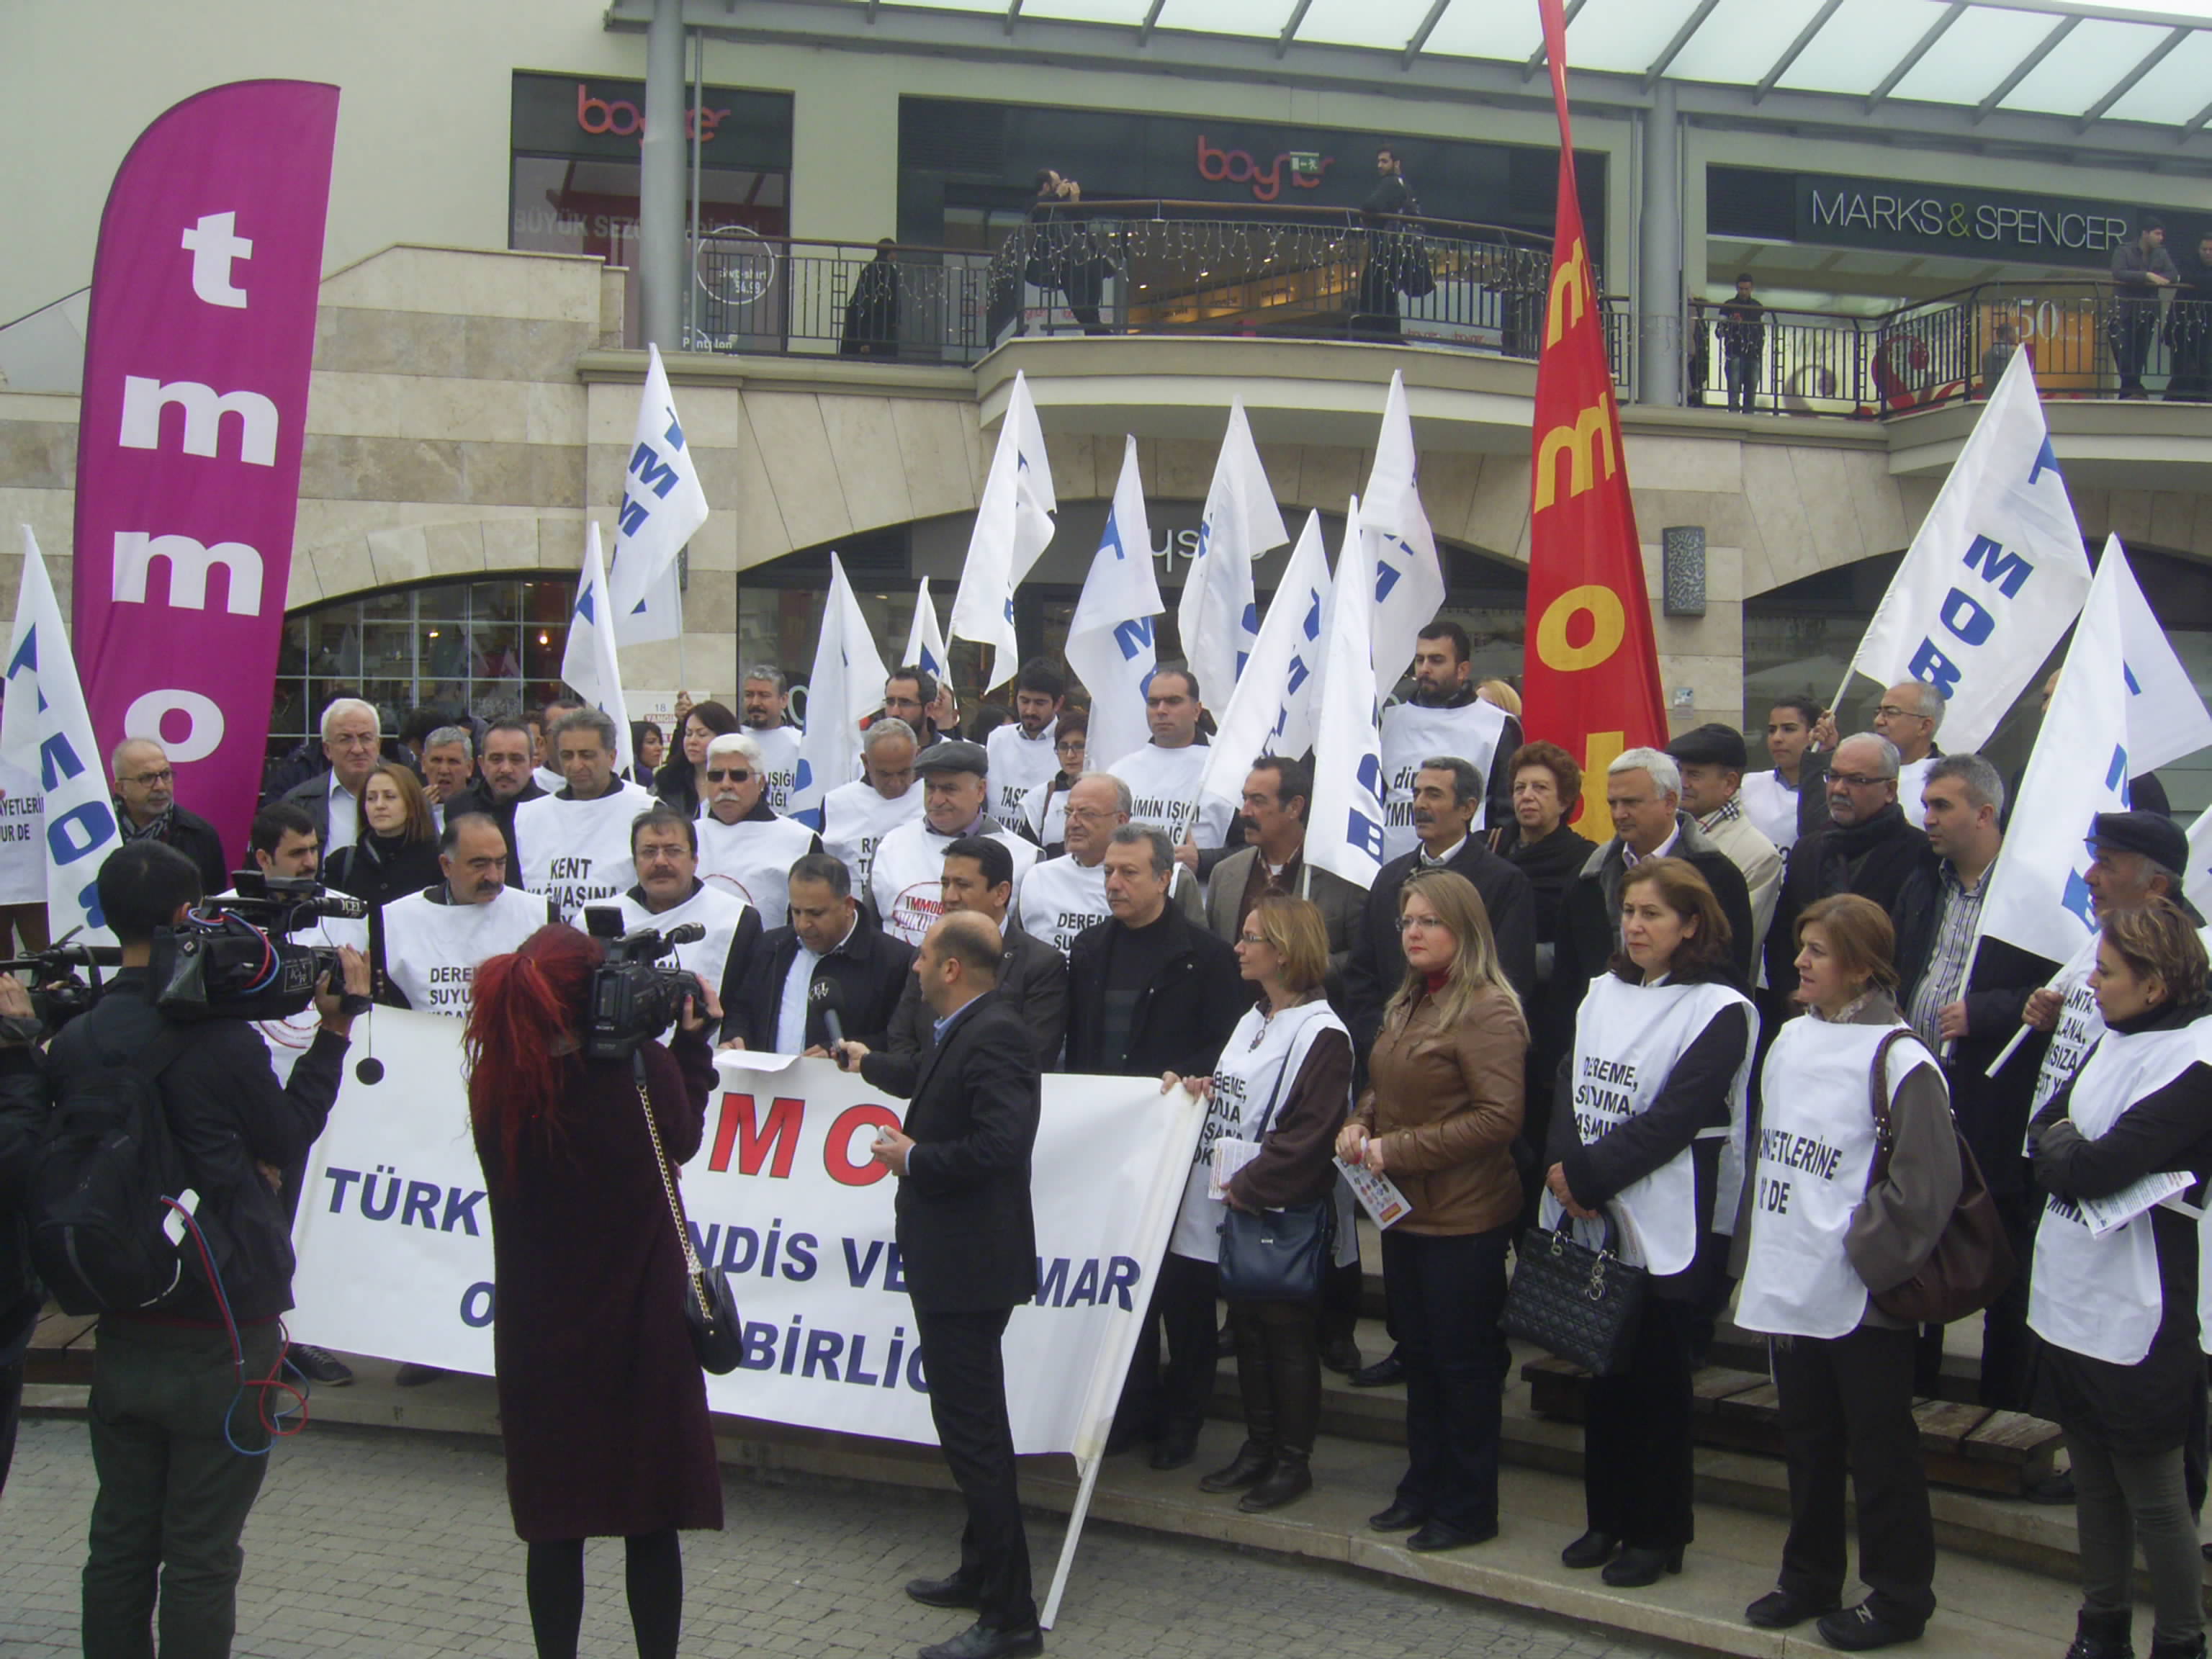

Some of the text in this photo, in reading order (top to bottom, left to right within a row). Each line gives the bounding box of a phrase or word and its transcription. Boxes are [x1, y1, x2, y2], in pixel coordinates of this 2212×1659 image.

[578, 84, 732, 150] boer
[1812, 189, 2128, 251] MARKS & SPENCER
[550, 857, 592, 880] KENT
[325, 1164, 489, 1237] TÜRK
[1768, 1179, 1791, 1215] DE
